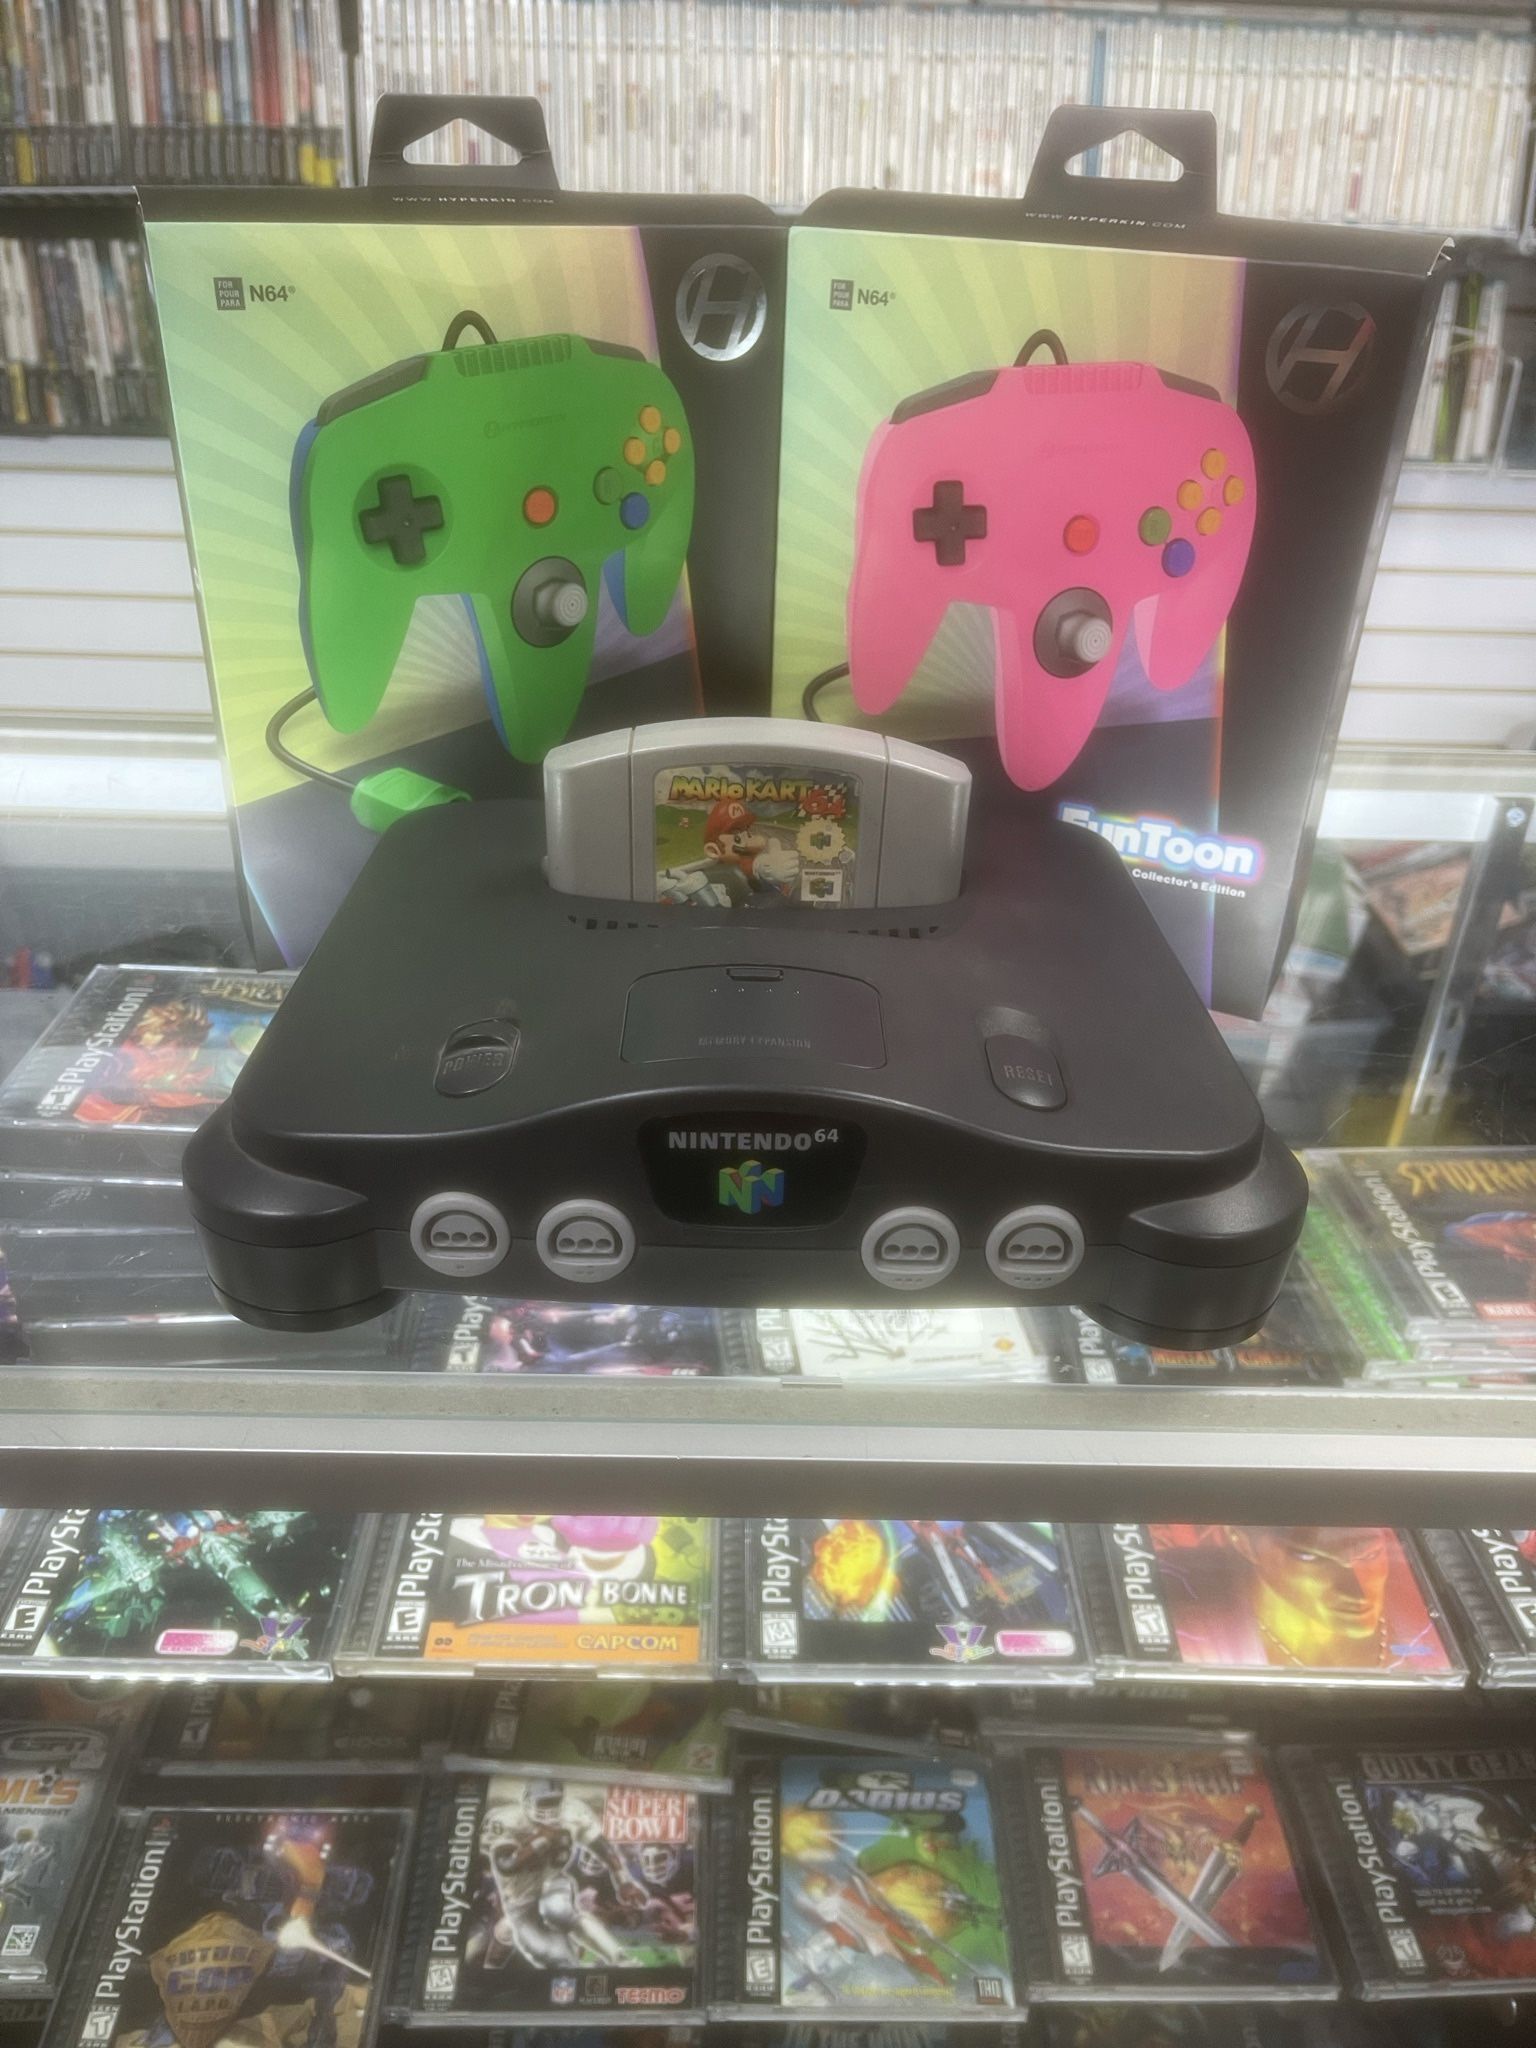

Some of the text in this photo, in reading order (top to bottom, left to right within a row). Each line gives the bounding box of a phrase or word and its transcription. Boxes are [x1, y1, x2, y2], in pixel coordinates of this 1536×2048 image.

[669, 775, 745, 801] MARIO
[746, 777, 813, 801] KART
[1131, 868, 1247, 899] Collector's Edition
[57, 991, 149, 1084] PlayStation
[1003, 1065, 1055, 1087] RESET
[668, 1128, 840, 1151] NINTENDO 64
[453, 1570, 688, 1625] TRON BONNE
[577, 1634, 679, 1651] CAPCOM
[1361, 1753, 1459, 1781] GUILTY
[607, 1797, 683, 1817] SUPER
[608, 1816, 684, 1841] BOWL
[1040, 1785, 1083, 1928] PlayStation
[1336, 1785, 1406, 1924] PlayStation
[431, 1803, 479, 1953] PlayStation
[746, 1797, 780, 1944] PlayStation
[95, 1848, 167, 1999] PlayStation
[615, 1986, 687, 2005] TECMO
[977, 1979, 1001, 1999] THQ
